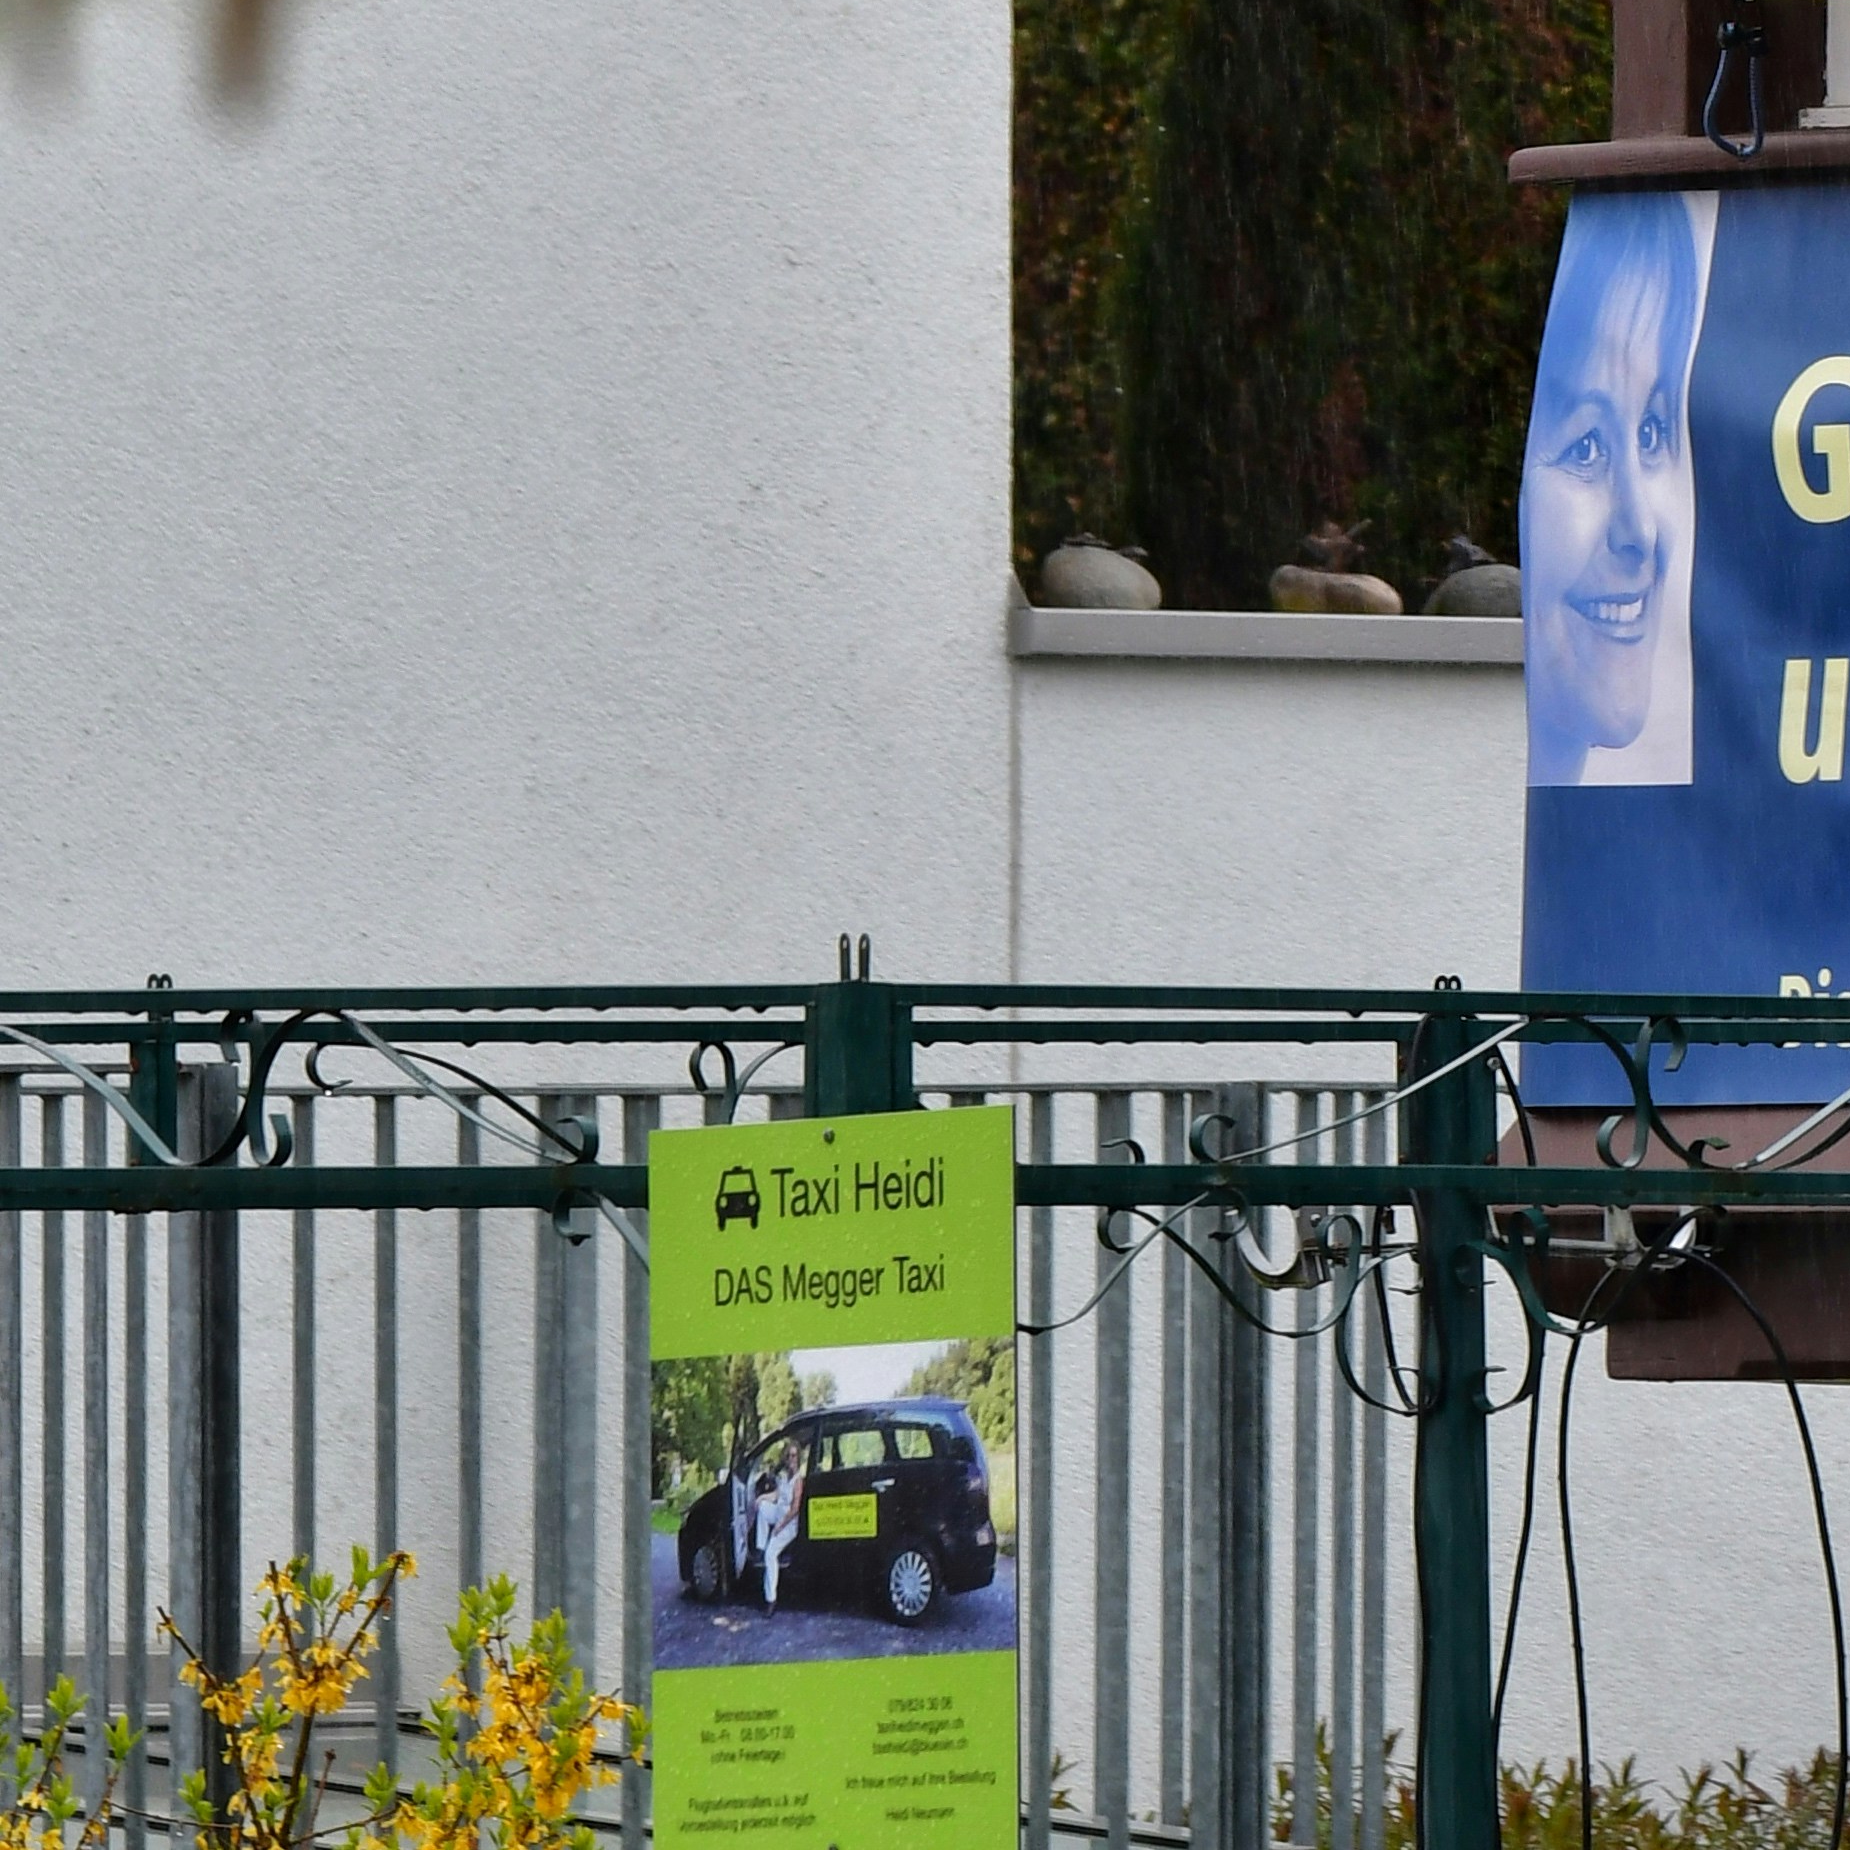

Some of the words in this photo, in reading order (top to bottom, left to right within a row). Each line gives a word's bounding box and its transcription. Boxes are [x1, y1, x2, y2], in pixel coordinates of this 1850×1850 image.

[770, 1163, 840, 1218] Taxi
[855, 1156, 944, 1213] Heidi
[714, 1265, 773, 1307] DAS
[782, 1262, 885, 1309] Megger
[892, 1253, 944, 1294] Taxi
